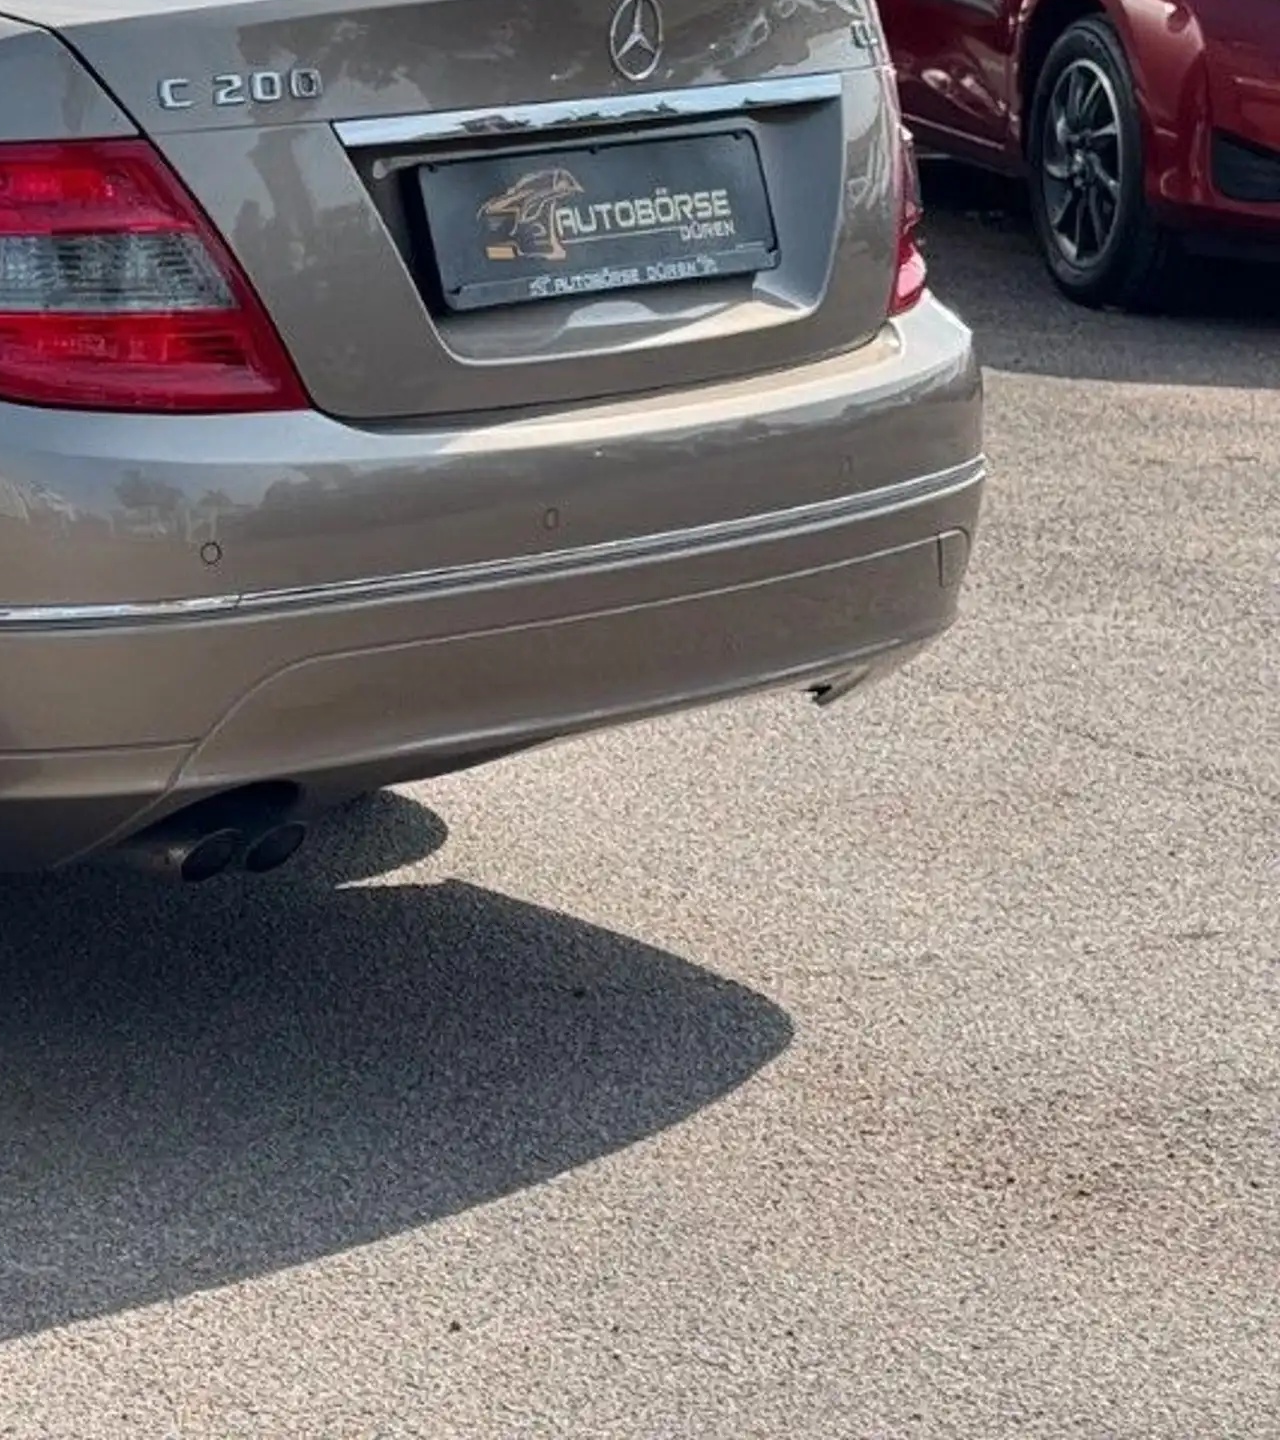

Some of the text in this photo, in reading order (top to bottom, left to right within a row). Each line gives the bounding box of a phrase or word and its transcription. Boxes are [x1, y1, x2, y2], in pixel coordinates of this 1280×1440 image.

[159, 68, 322, 108] C 200
[555, 187, 732, 236] AUTOBÖRSE
[680, 219, 736, 241] DÜREN
